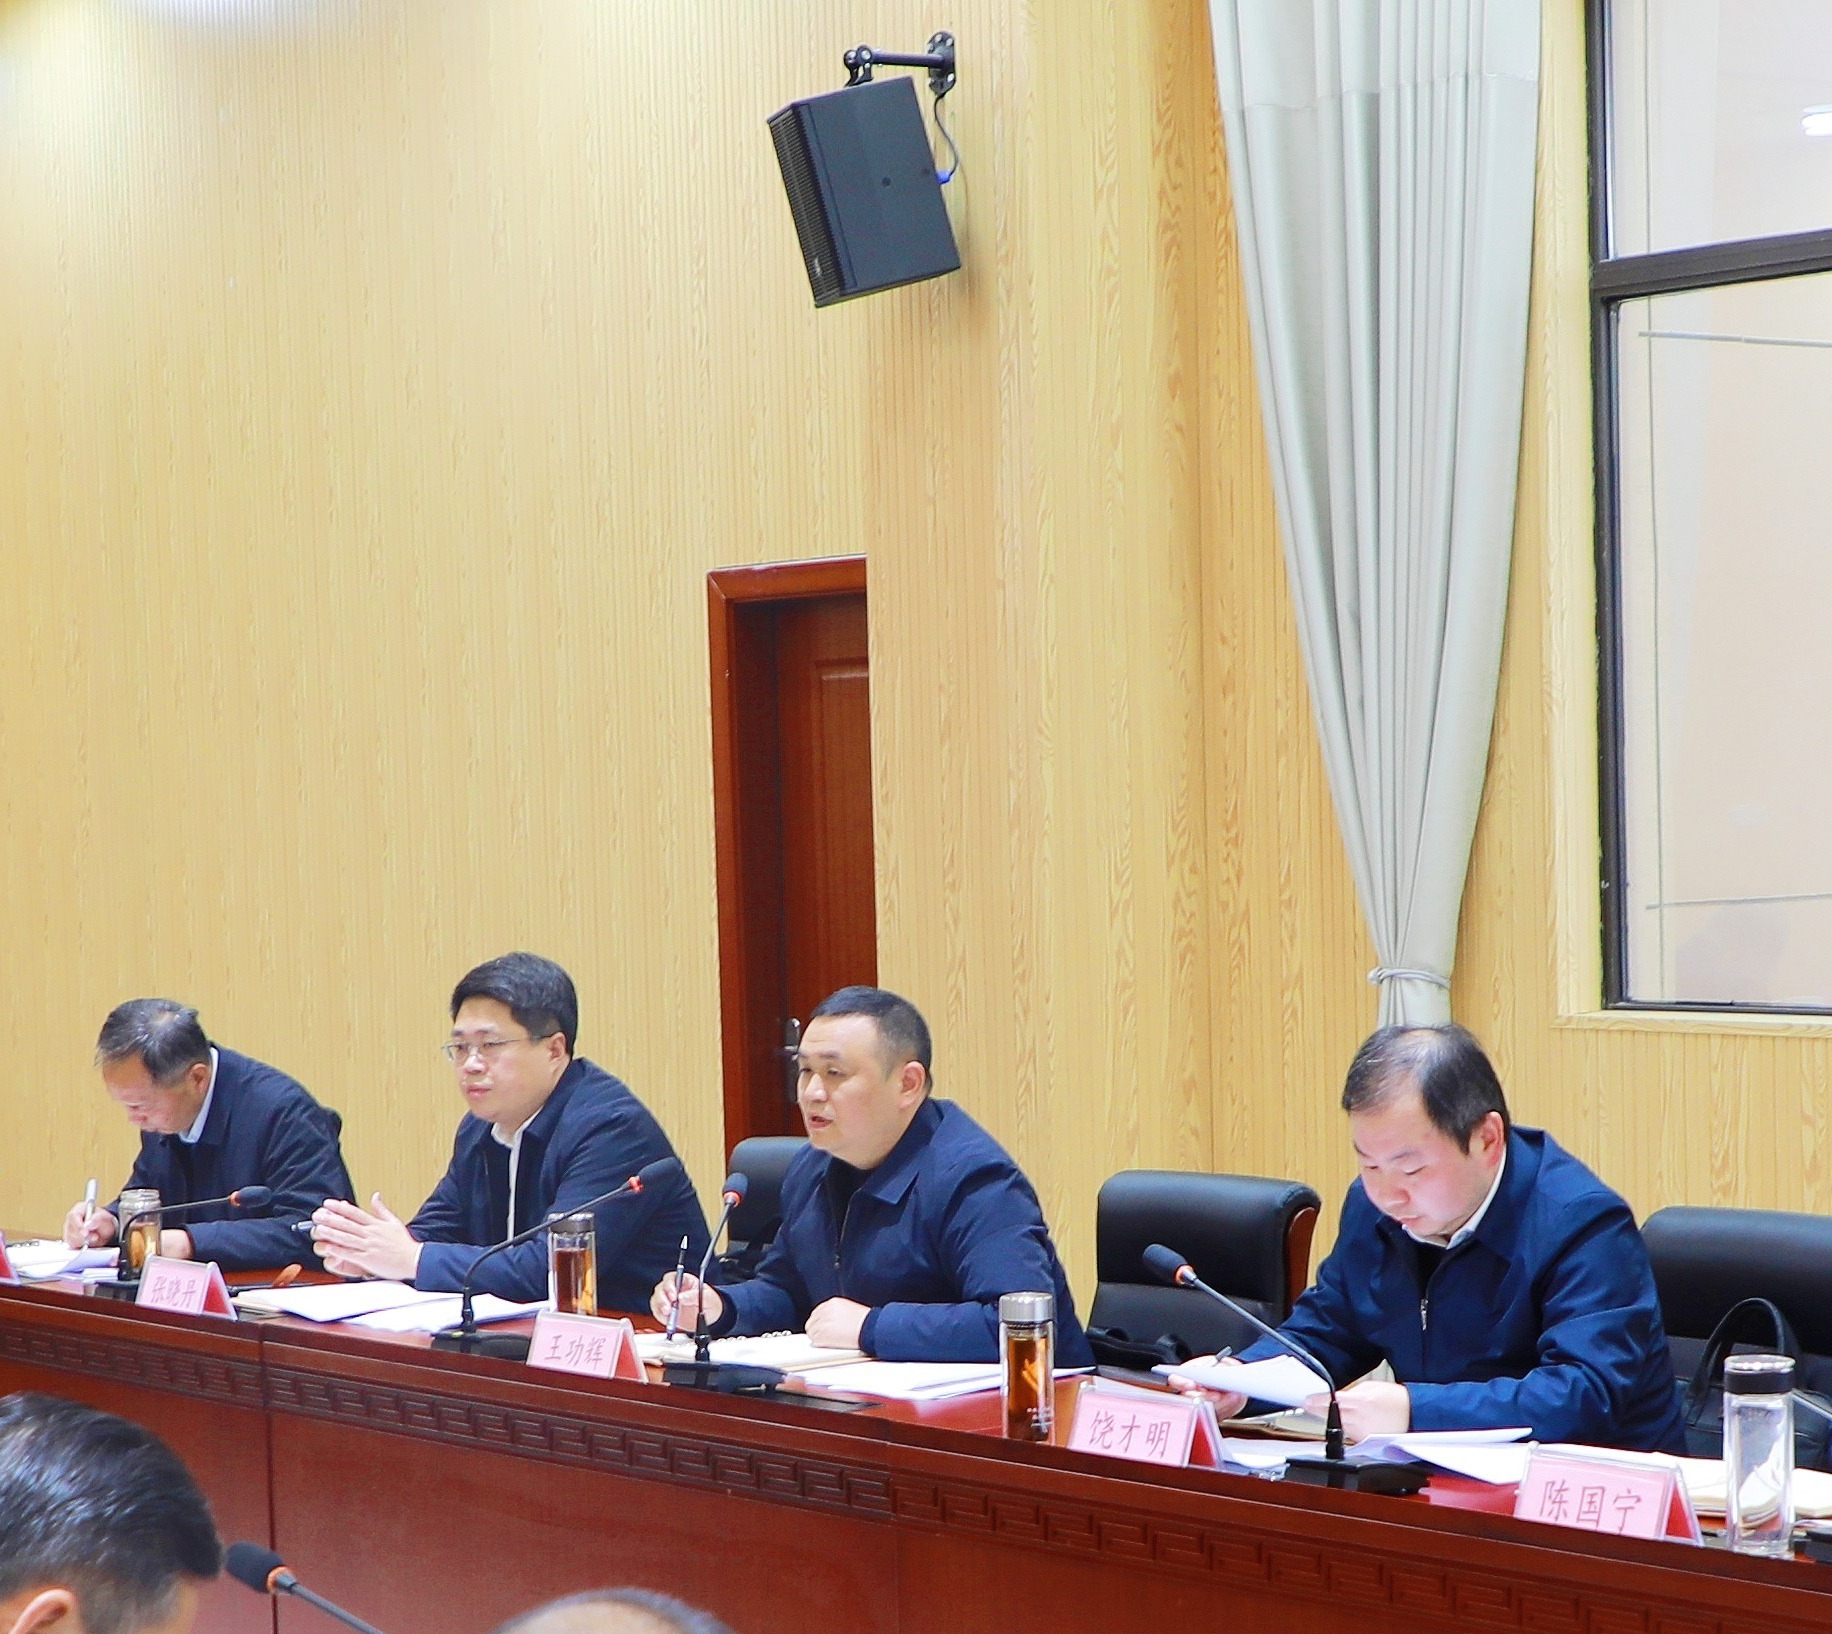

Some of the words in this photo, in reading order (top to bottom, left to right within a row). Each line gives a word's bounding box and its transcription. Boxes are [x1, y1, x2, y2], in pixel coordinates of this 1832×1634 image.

[1088, 1410, 1172, 1459] 饶才明
[1539, 1478, 1643, 1534] 陈国宁
